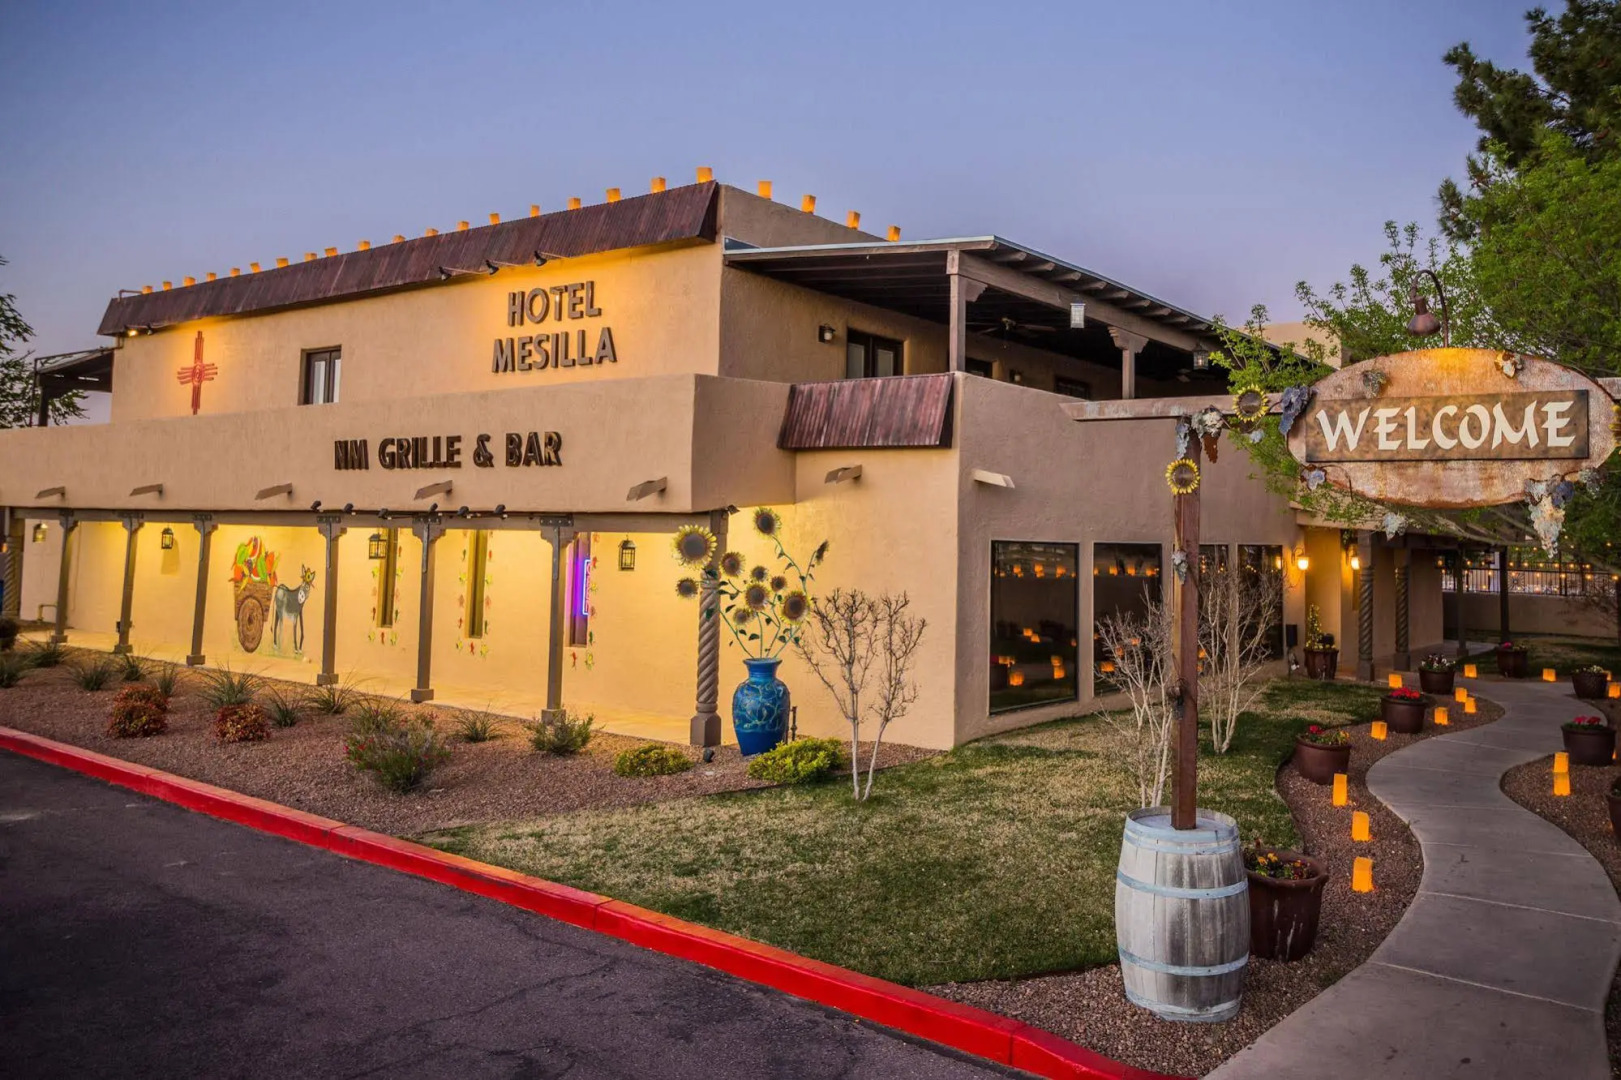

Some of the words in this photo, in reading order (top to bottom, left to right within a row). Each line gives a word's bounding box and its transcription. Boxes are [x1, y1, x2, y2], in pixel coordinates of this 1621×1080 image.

[507, 281, 602, 327] HOTEL
[491, 326, 617, 373] MESILLA
[1315, 400, 1575, 452] WELCOME
[378, 435, 462, 469] GRILLE
[473, 434, 494, 468] &
[505, 431, 563, 467] BAR
